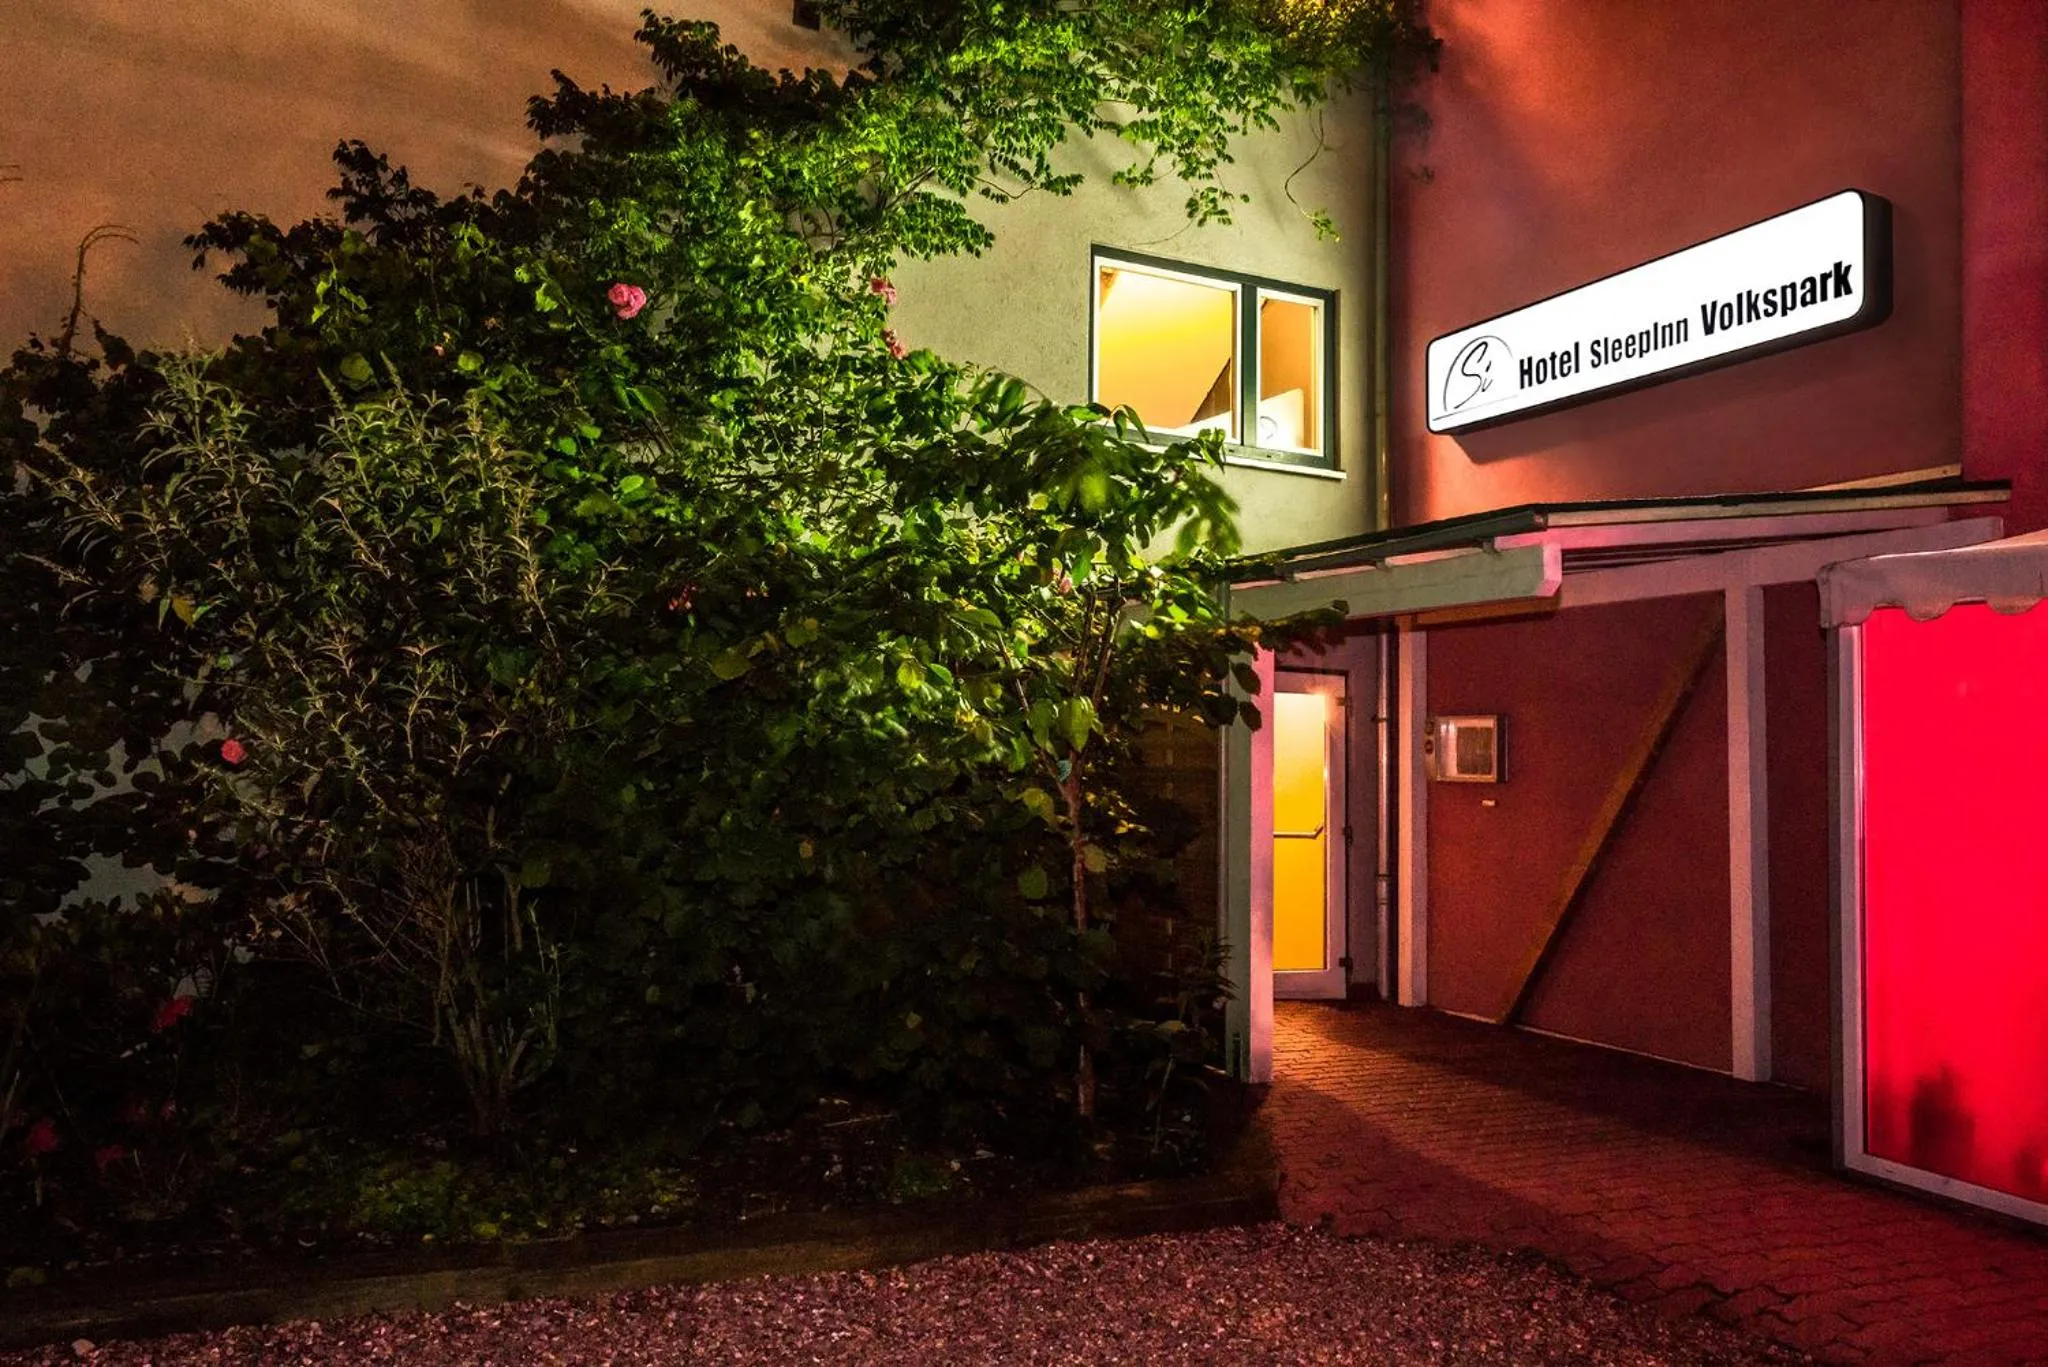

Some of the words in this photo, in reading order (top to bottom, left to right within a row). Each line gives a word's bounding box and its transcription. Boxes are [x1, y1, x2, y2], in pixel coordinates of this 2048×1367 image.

[1519, 341, 1580, 390] Hotel
[1590, 317, 1689, 369] SleepInn
[1700, 260, 1853, 337] Volkspark
